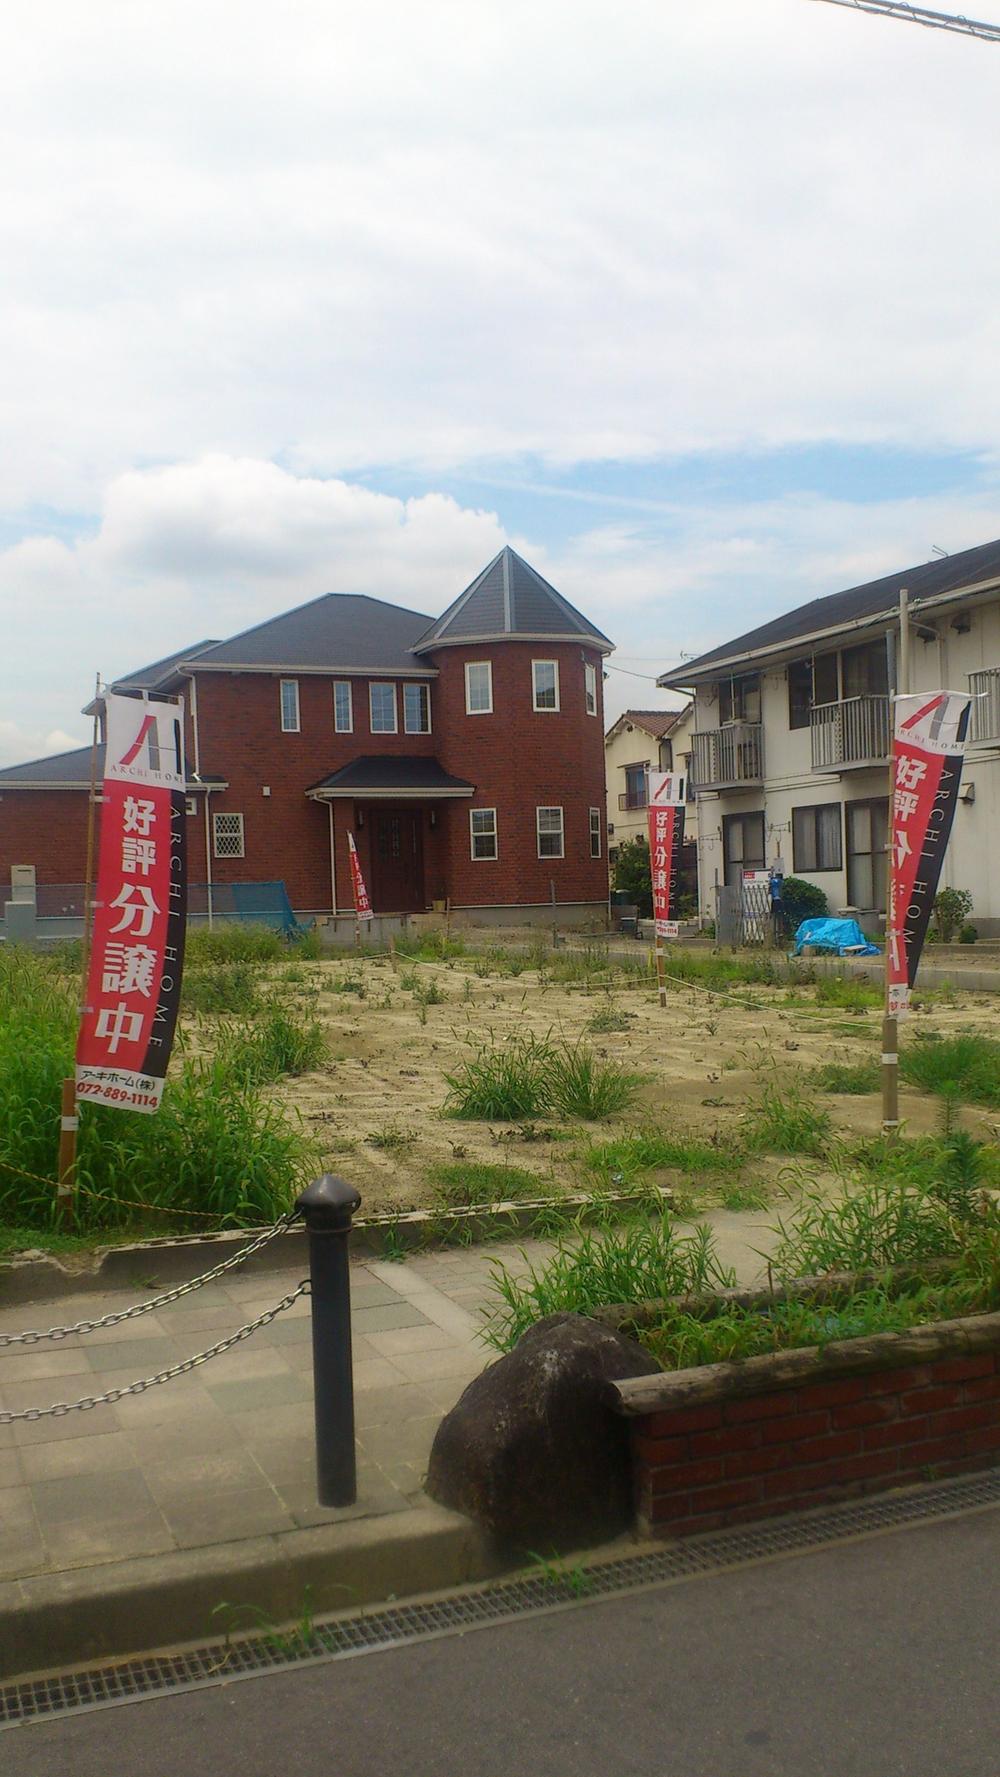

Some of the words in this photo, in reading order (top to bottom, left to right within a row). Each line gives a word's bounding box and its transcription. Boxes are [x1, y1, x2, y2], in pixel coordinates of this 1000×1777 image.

[168, 806, 182, 916] ARCHI
[920, 768, 955, 858] ARCHI
[94, 795, 162, 1054] 好評分譲中
[148, 946, 177, 1047] HOME
[76, 1082, 158, 1108] 072-889-1114
